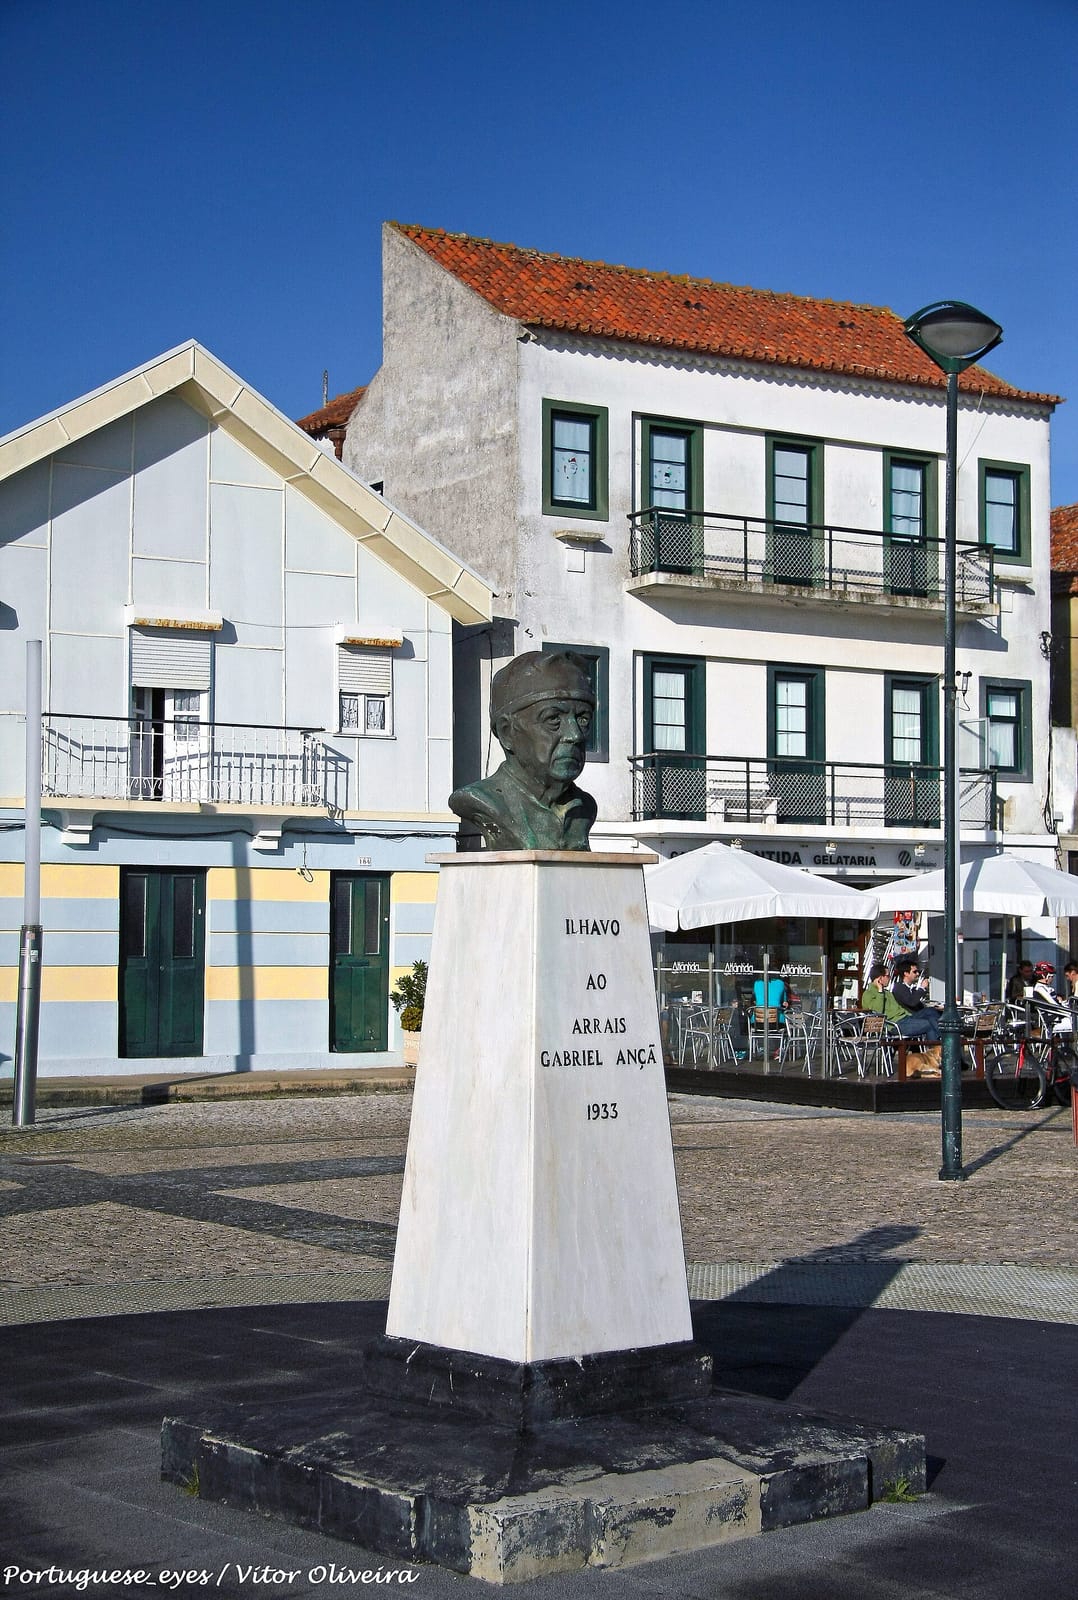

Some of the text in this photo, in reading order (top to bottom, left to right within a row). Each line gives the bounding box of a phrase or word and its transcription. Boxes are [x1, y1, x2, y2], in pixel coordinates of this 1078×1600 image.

[813, 855, 876, 866] GELATARIA
[565, 918, 620, 936] ILHAVO
[586, 973, 607, 990] AO
[572, 1017, 627, 1034] ARRAIS
[541, 1044, 657, 1070] GABRIEL ANÇÃ
[587, 1103, 619, 1120] 1933
